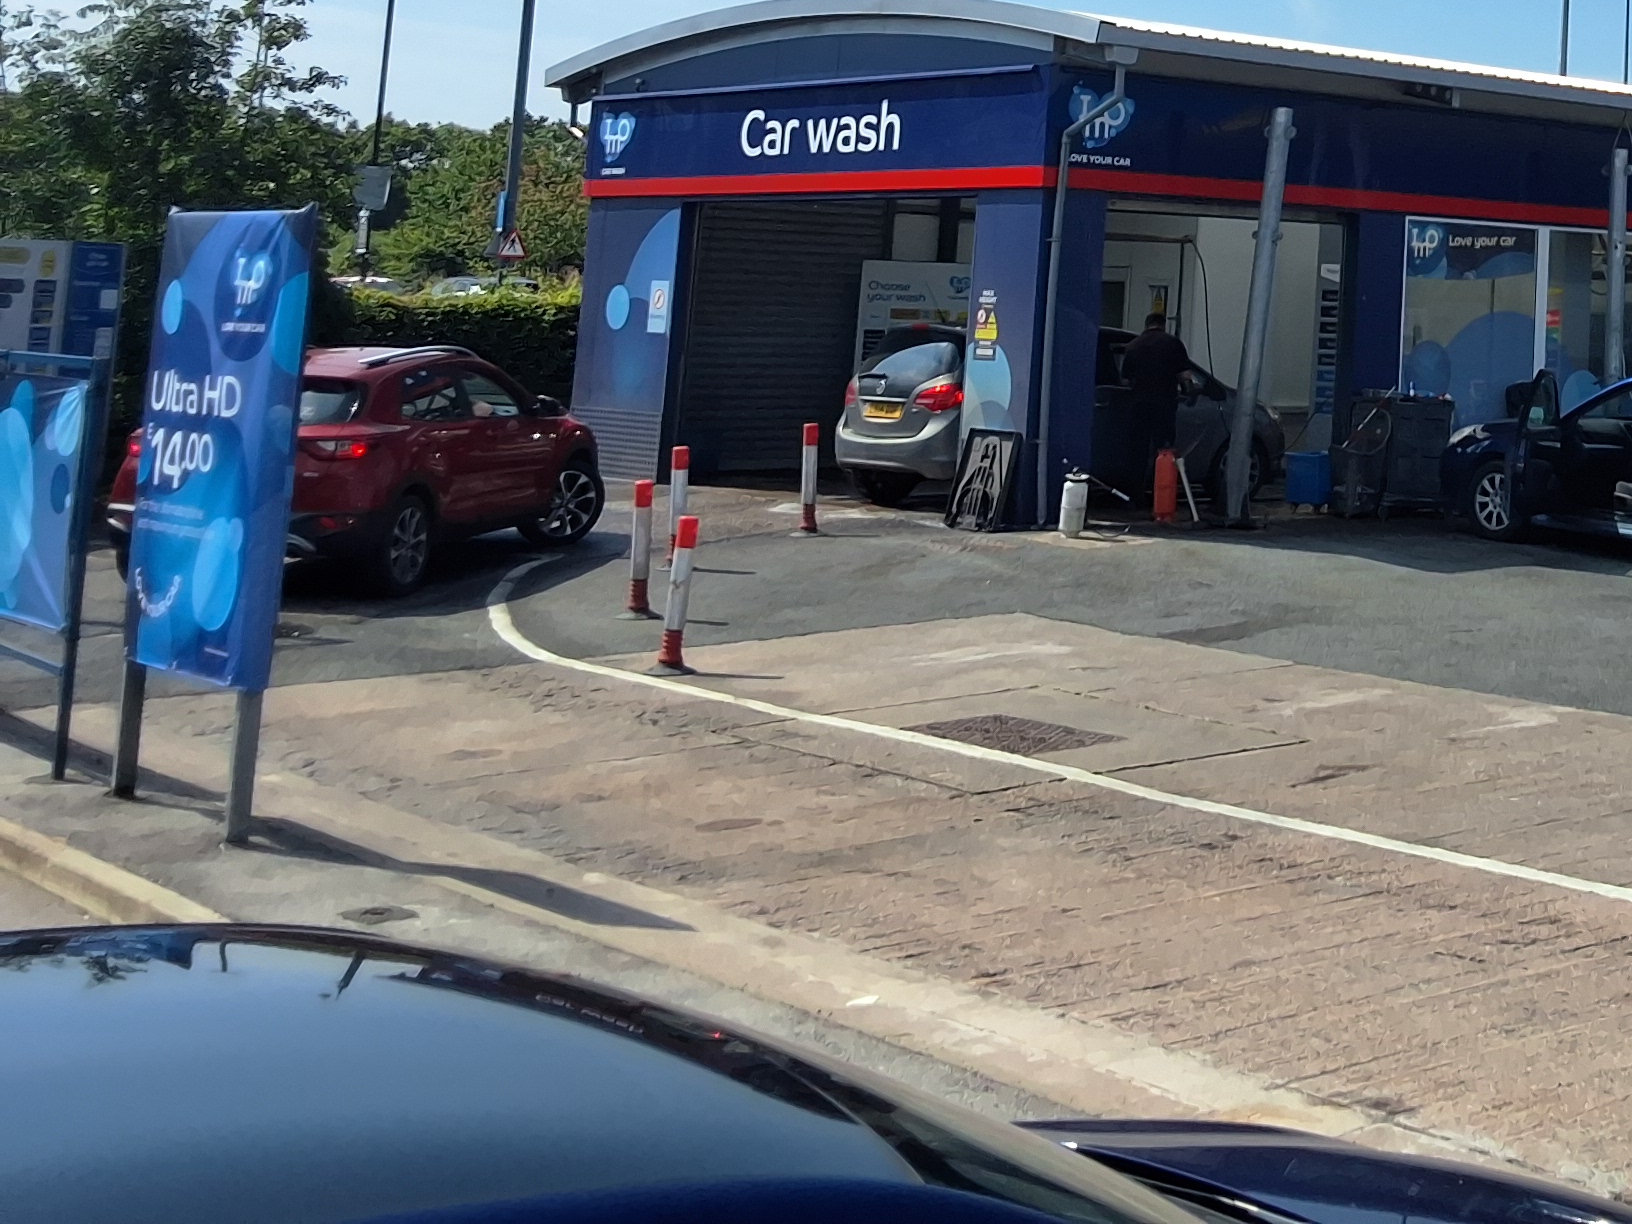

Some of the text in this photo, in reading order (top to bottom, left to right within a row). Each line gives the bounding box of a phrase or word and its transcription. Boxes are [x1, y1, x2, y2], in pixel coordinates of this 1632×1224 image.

[740, 98, 901, 157] Car wash
[1089, 154, 1113, 165] YOUR
[1113, 156, 1131, 166] CAR
[1448, 234, 1517, 249] Love your car
[868, 280, 911, 292] Choose
[867, 292, 926, 303] your wash
[151, 368, 243, 419] Ultra HD
